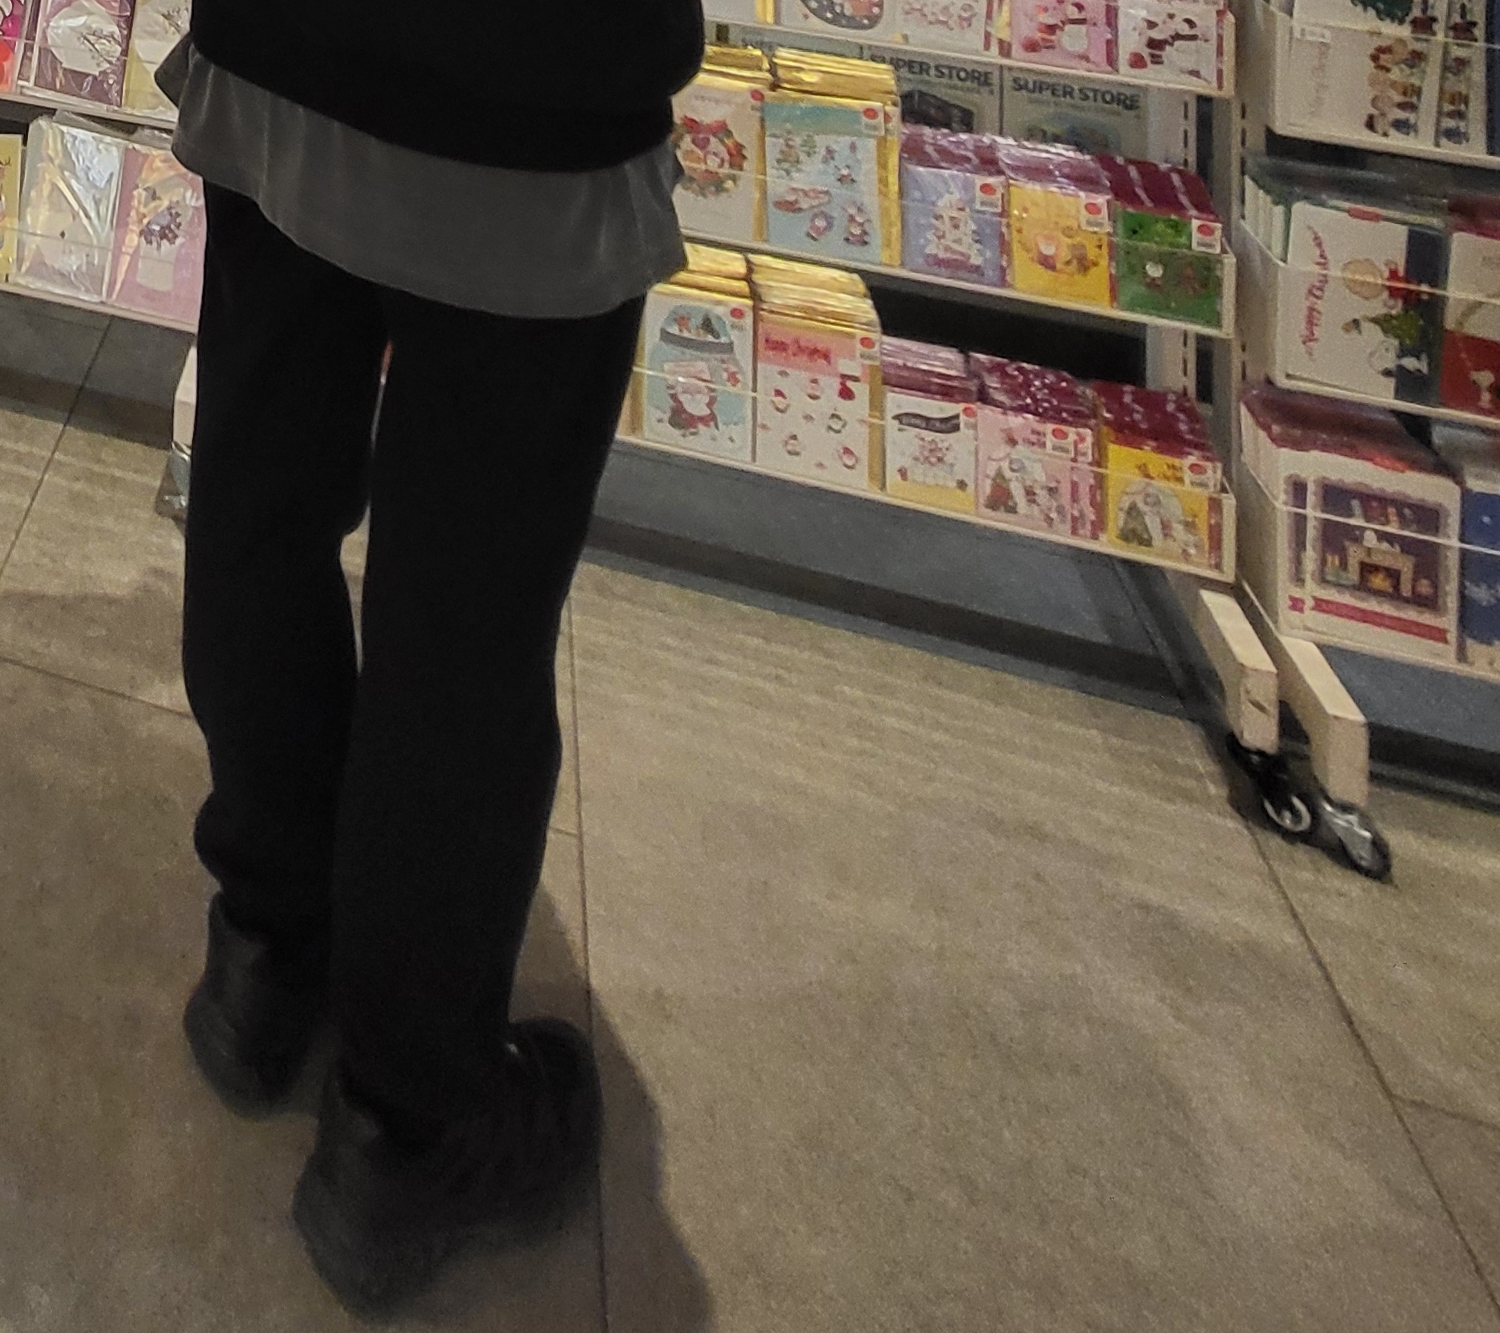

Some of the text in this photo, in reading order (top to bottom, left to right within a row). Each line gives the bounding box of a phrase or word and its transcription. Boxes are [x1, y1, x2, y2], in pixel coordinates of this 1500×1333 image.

[936, 61, 995, 87] STORE
[1012, 75, 1142, 112] SUPER STORE
